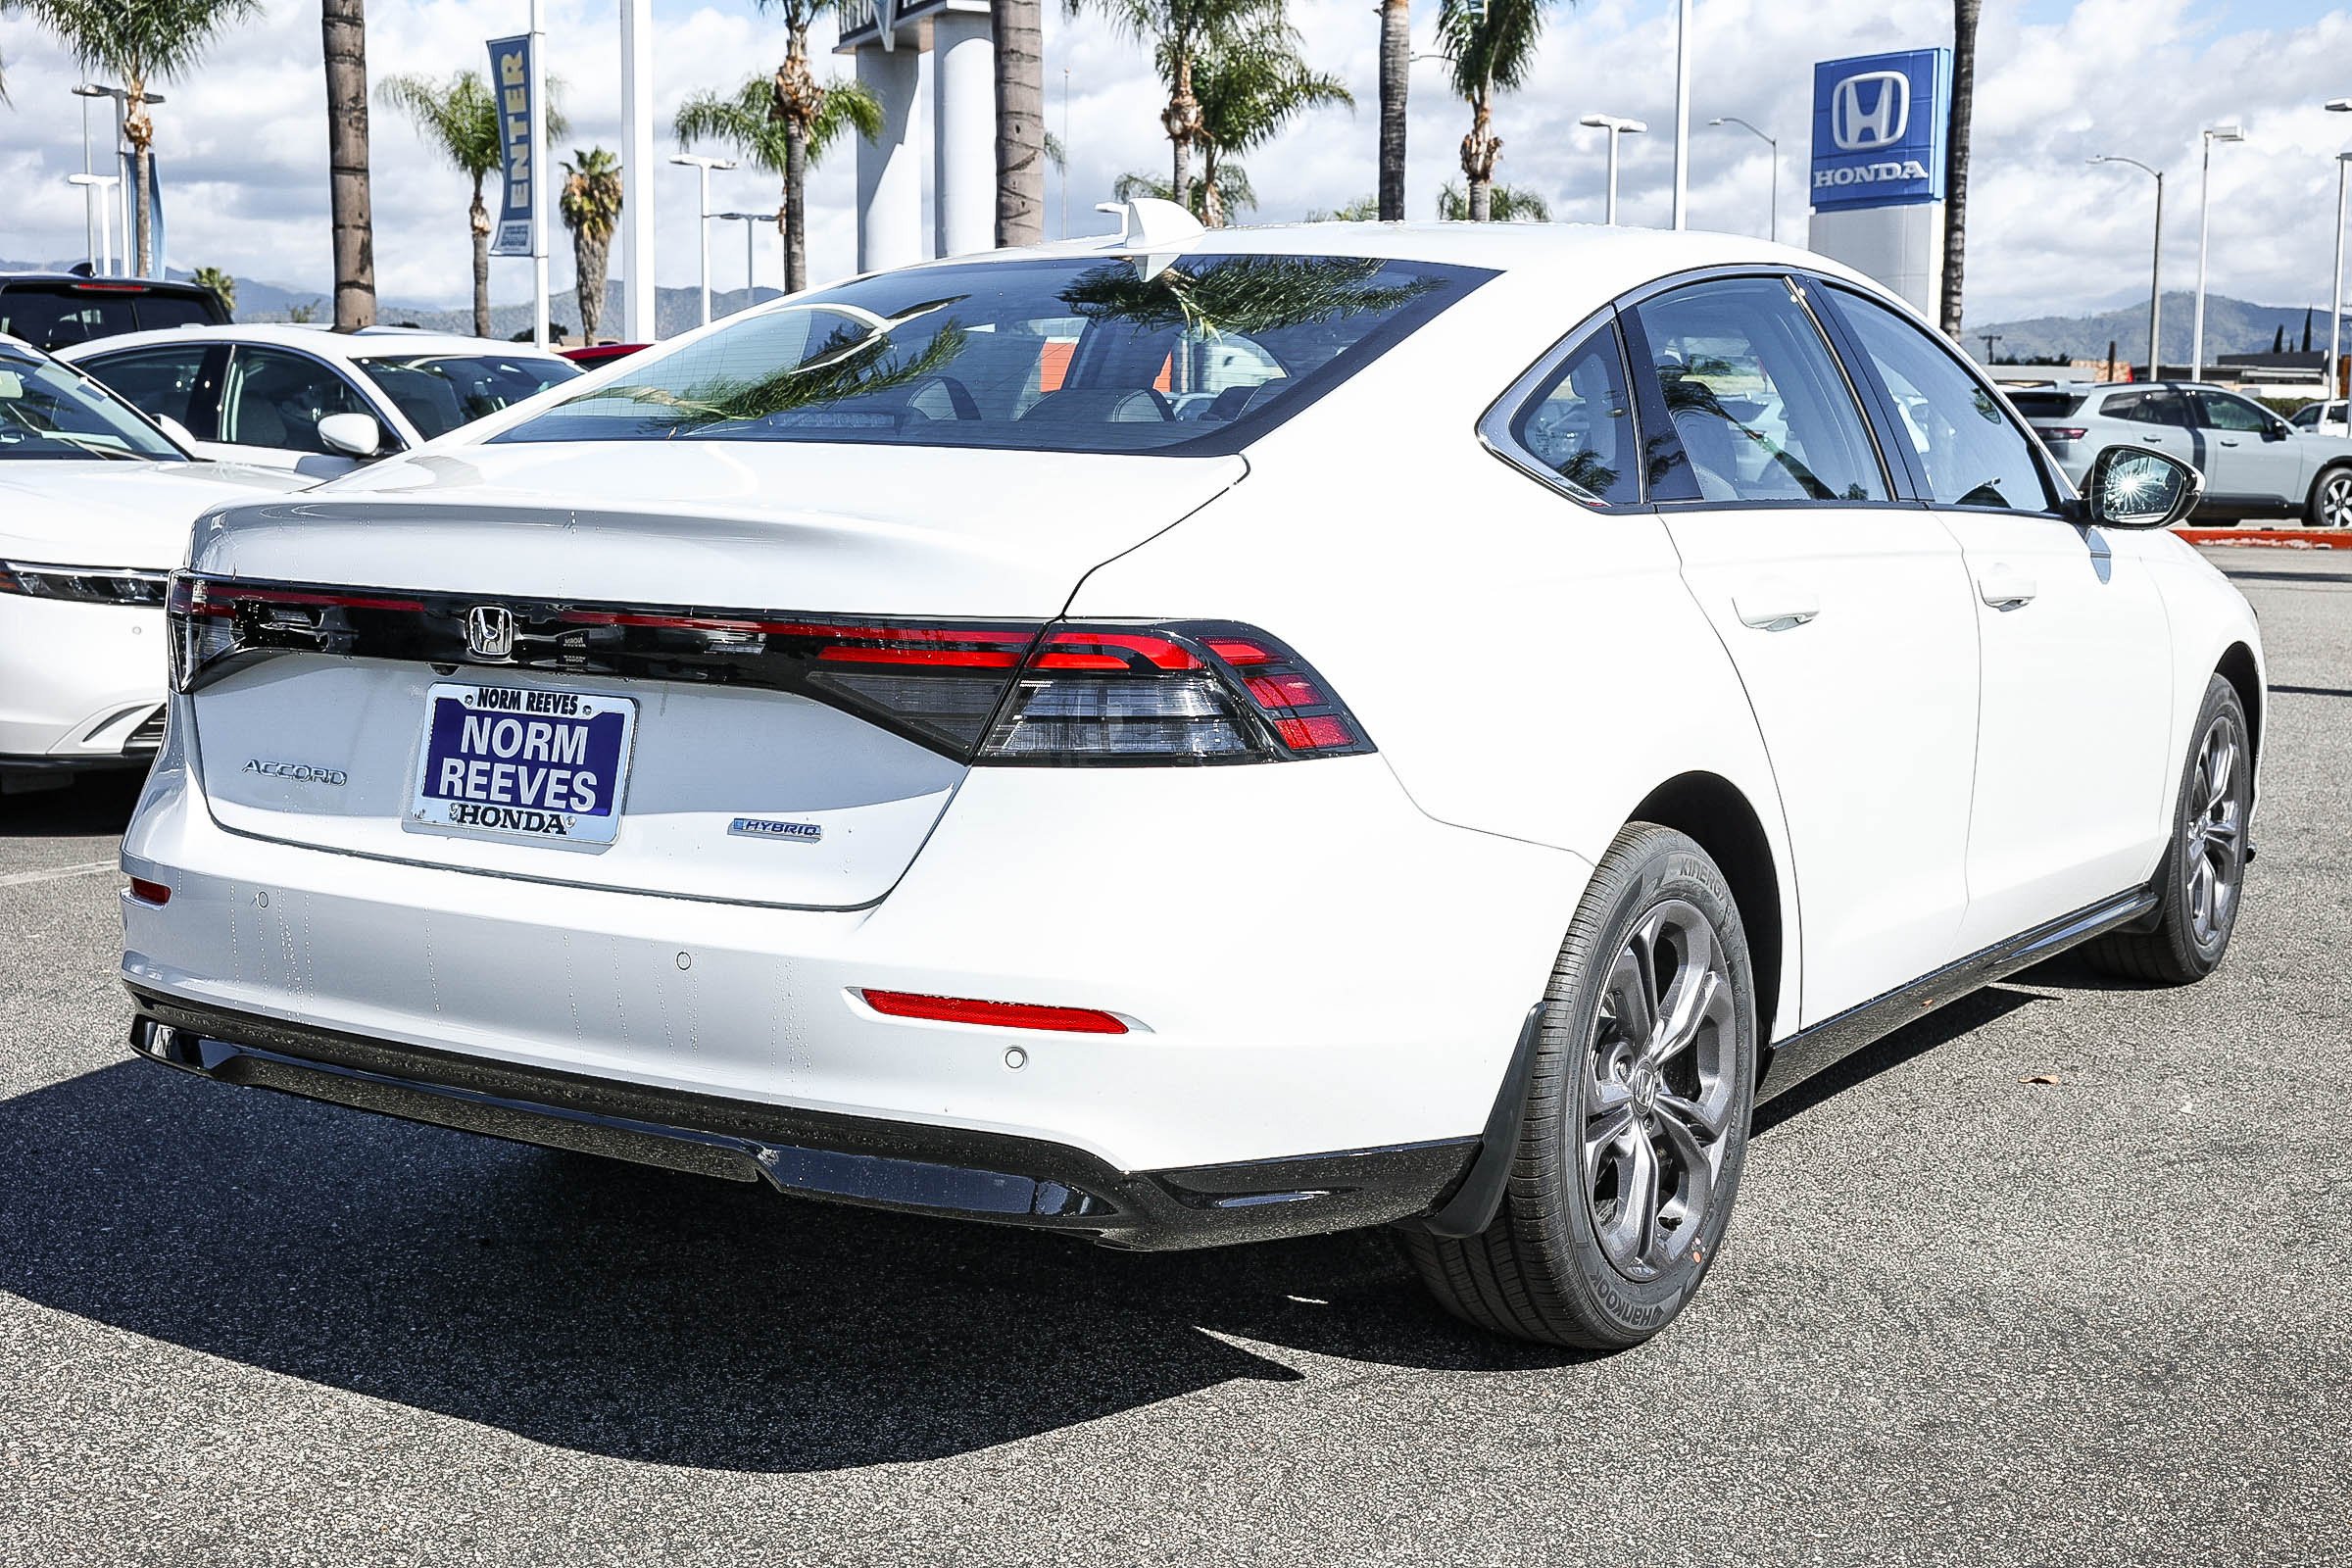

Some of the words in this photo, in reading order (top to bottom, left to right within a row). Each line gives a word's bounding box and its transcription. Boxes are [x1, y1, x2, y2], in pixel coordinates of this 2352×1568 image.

[501, 50, 529, 209] ENTER
[1814, 161, 1929, 188] HONDA
[477, 688, 521, 710] NORM
[525, 691, 578, 715] REEVES
[461, 715, 588, 765] NORM
[242, 759, 348, 786] ACCORD
[438, 758, 598, 812] REEVES
[457, 804, 567, 835] HONDA
[745, 820, 817, 836] HYBRID
